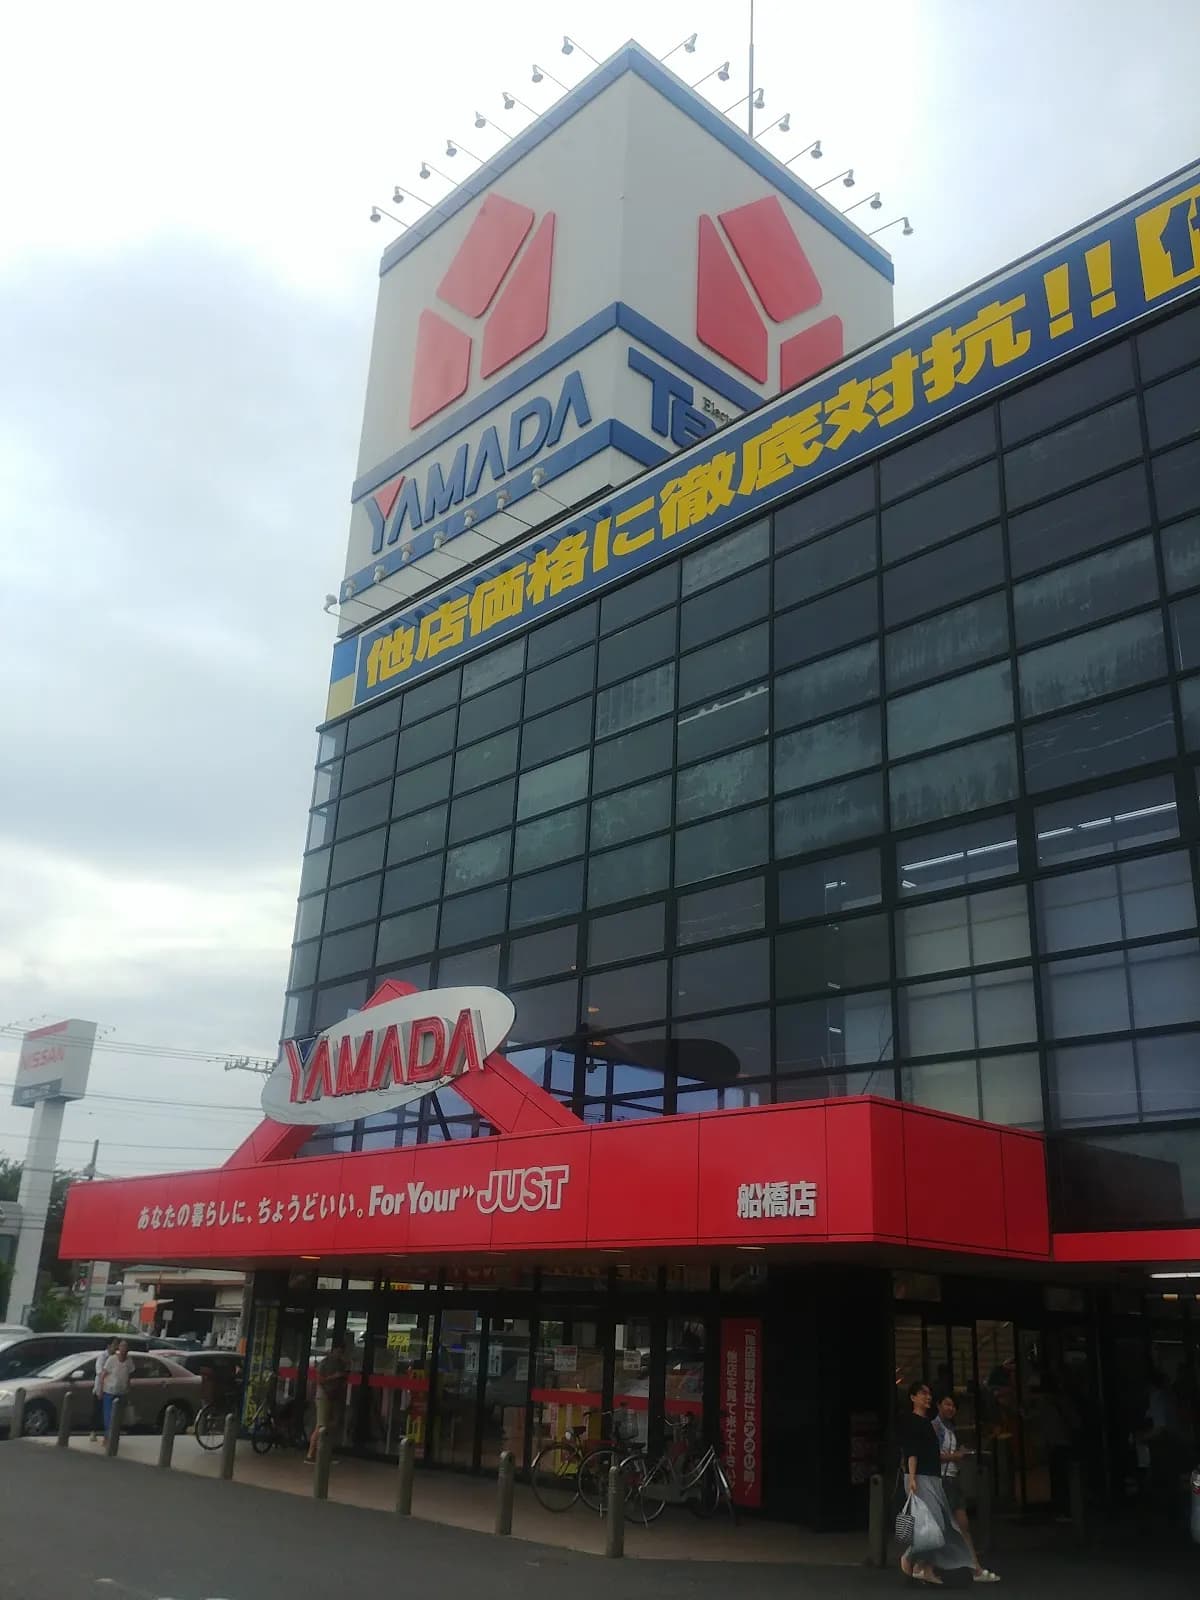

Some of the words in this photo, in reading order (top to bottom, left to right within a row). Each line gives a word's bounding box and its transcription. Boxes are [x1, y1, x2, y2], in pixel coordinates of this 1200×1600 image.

[371, 369, 592, 555] YAMADA
[284, 1007, 487, 1104] YAMADA
[476, 1164, 570, 1214] JUST
[736, 1180, 818, 1219] 船橋店
